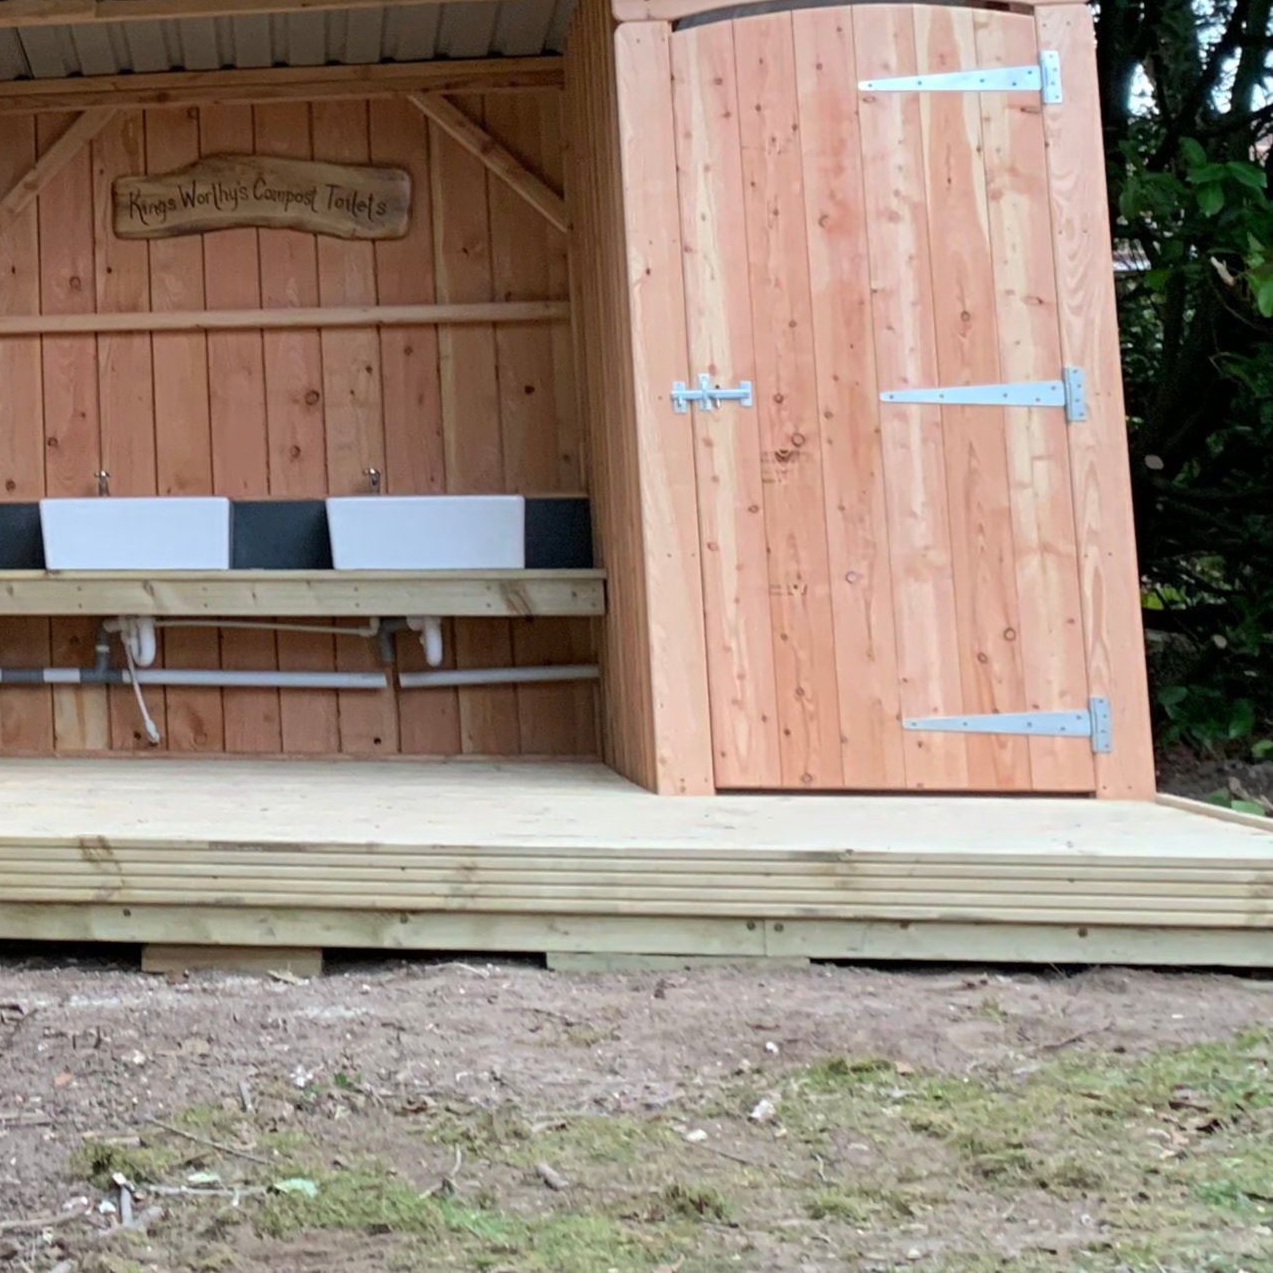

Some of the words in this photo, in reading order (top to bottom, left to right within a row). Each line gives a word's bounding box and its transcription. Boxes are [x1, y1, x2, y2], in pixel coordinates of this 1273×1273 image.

[129, 190, 176, 225] Kings
[252, 176, 318, 213] Compost
[325, 183, 387, 221] Toilets
